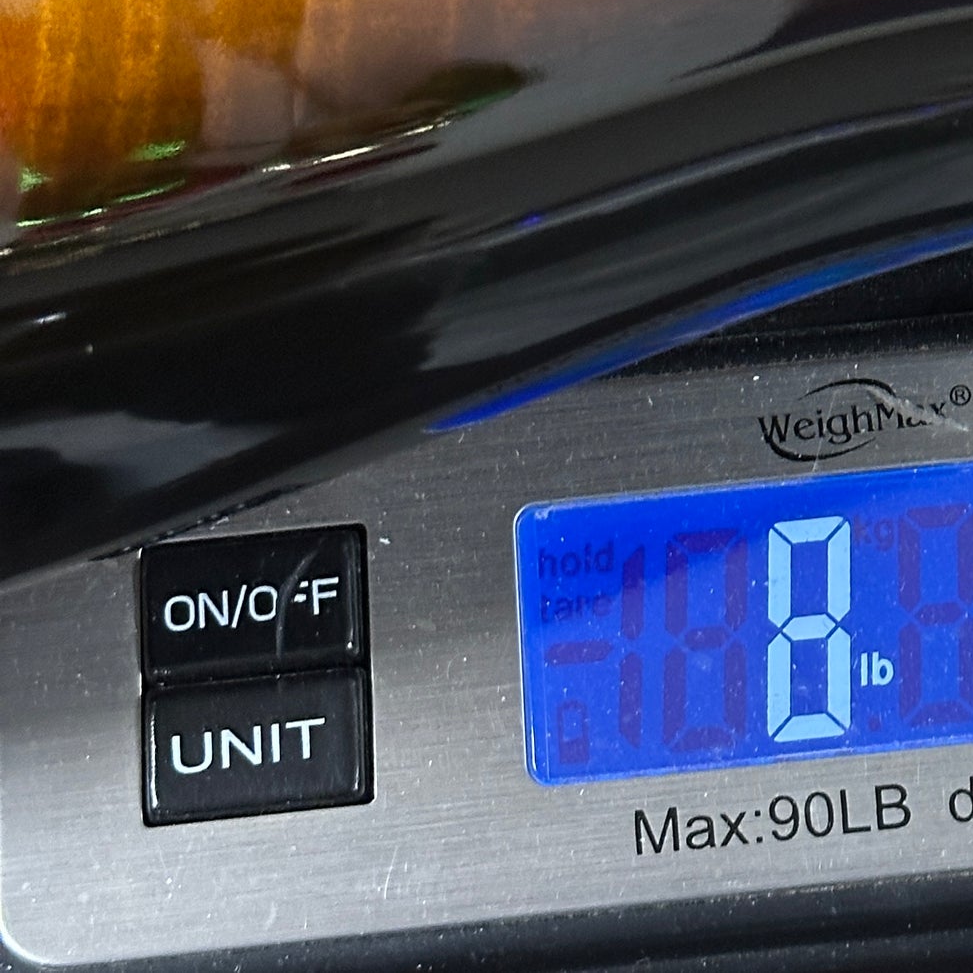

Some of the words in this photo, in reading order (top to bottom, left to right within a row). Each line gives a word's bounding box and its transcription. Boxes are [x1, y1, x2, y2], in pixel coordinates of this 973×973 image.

[163, 576, 340, 632] ON/OF
[767, 515, 852, 743] 8
[860, 650, 895, 687] lb
[170, 717, 326, 775] UNIT
[633, 782, 913, 855] Max:90LB
